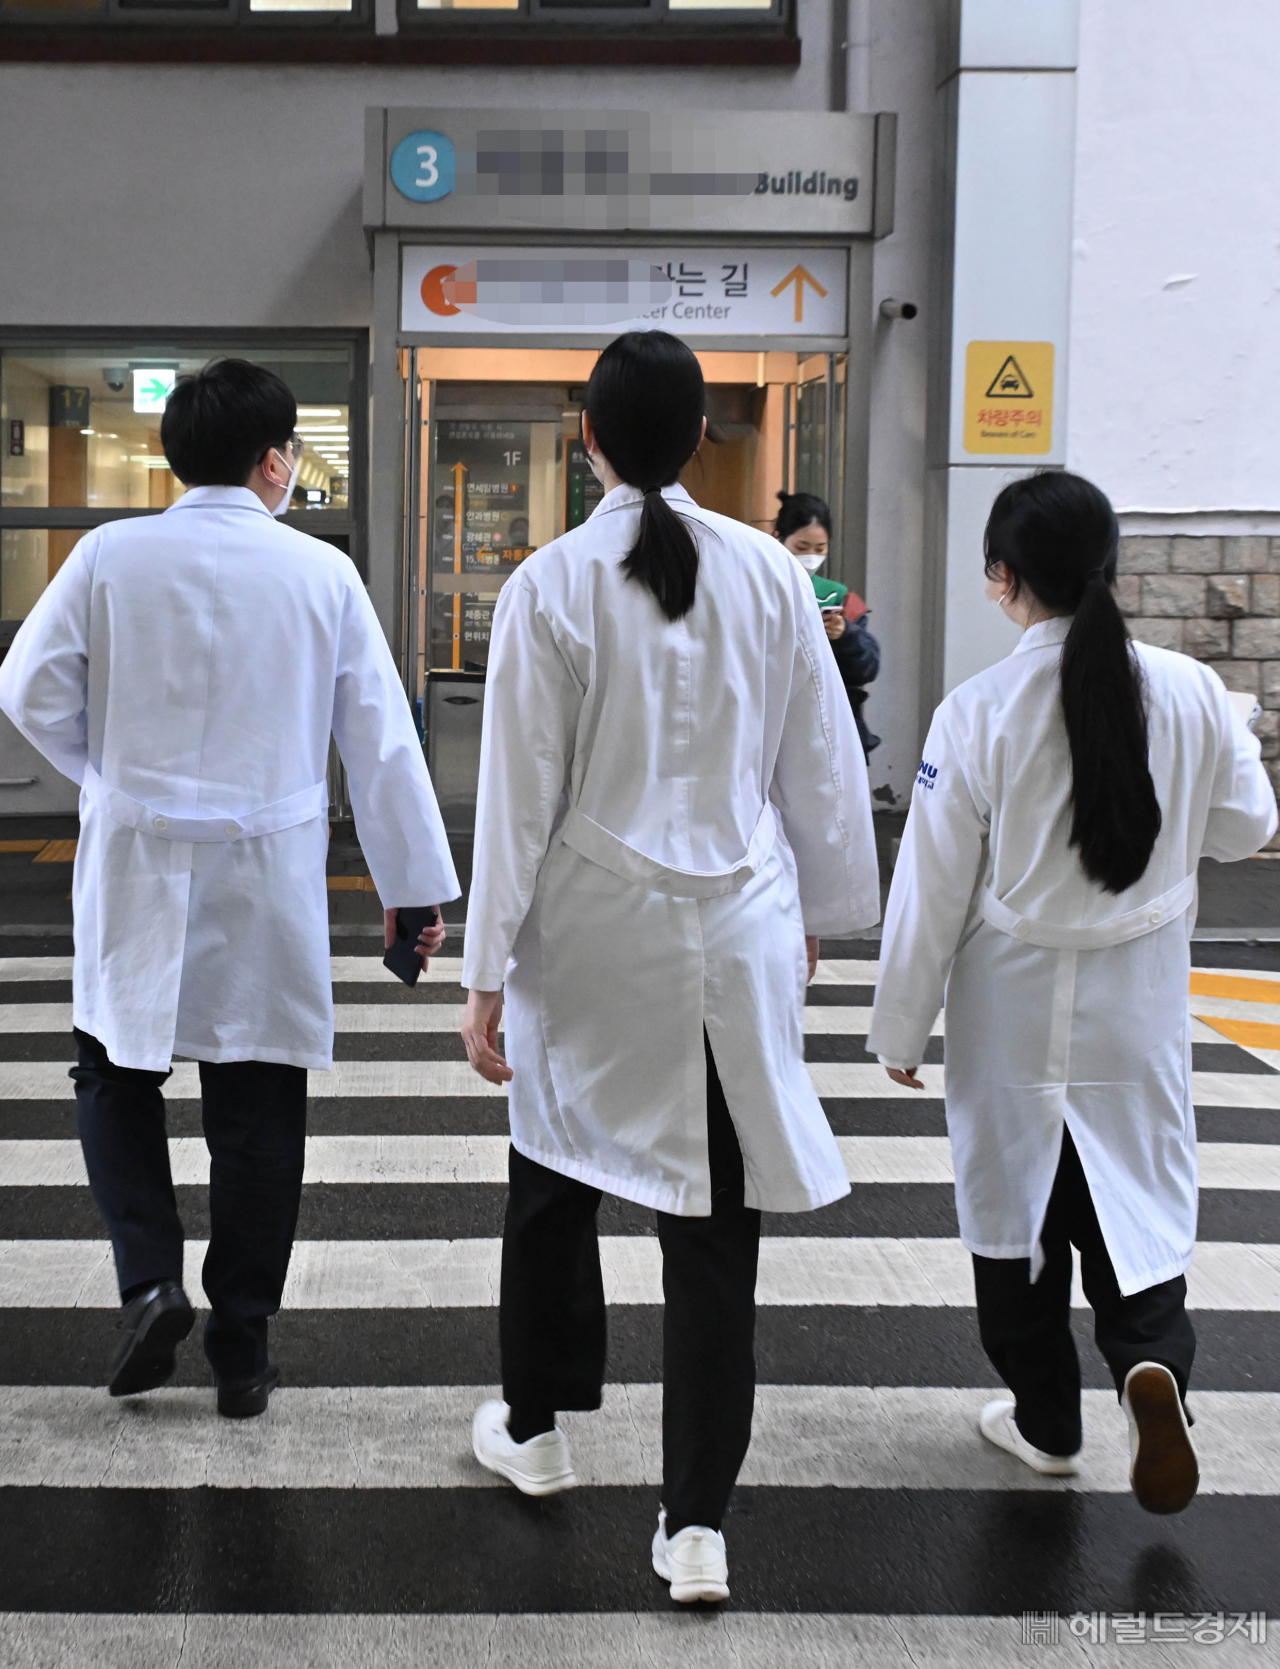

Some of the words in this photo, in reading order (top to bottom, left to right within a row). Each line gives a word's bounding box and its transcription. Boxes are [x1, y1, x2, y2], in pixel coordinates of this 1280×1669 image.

[415, 145, 439, 187] 3
[755, 171, 859, 201] Building
[721, 262, 748, 297] 길
[672, 302, 731, 319] Center
[62, 389, 87, 408] 17
[977, 409, 1043, 427] 차량주의
[503, 451, 522, 466] 1F
